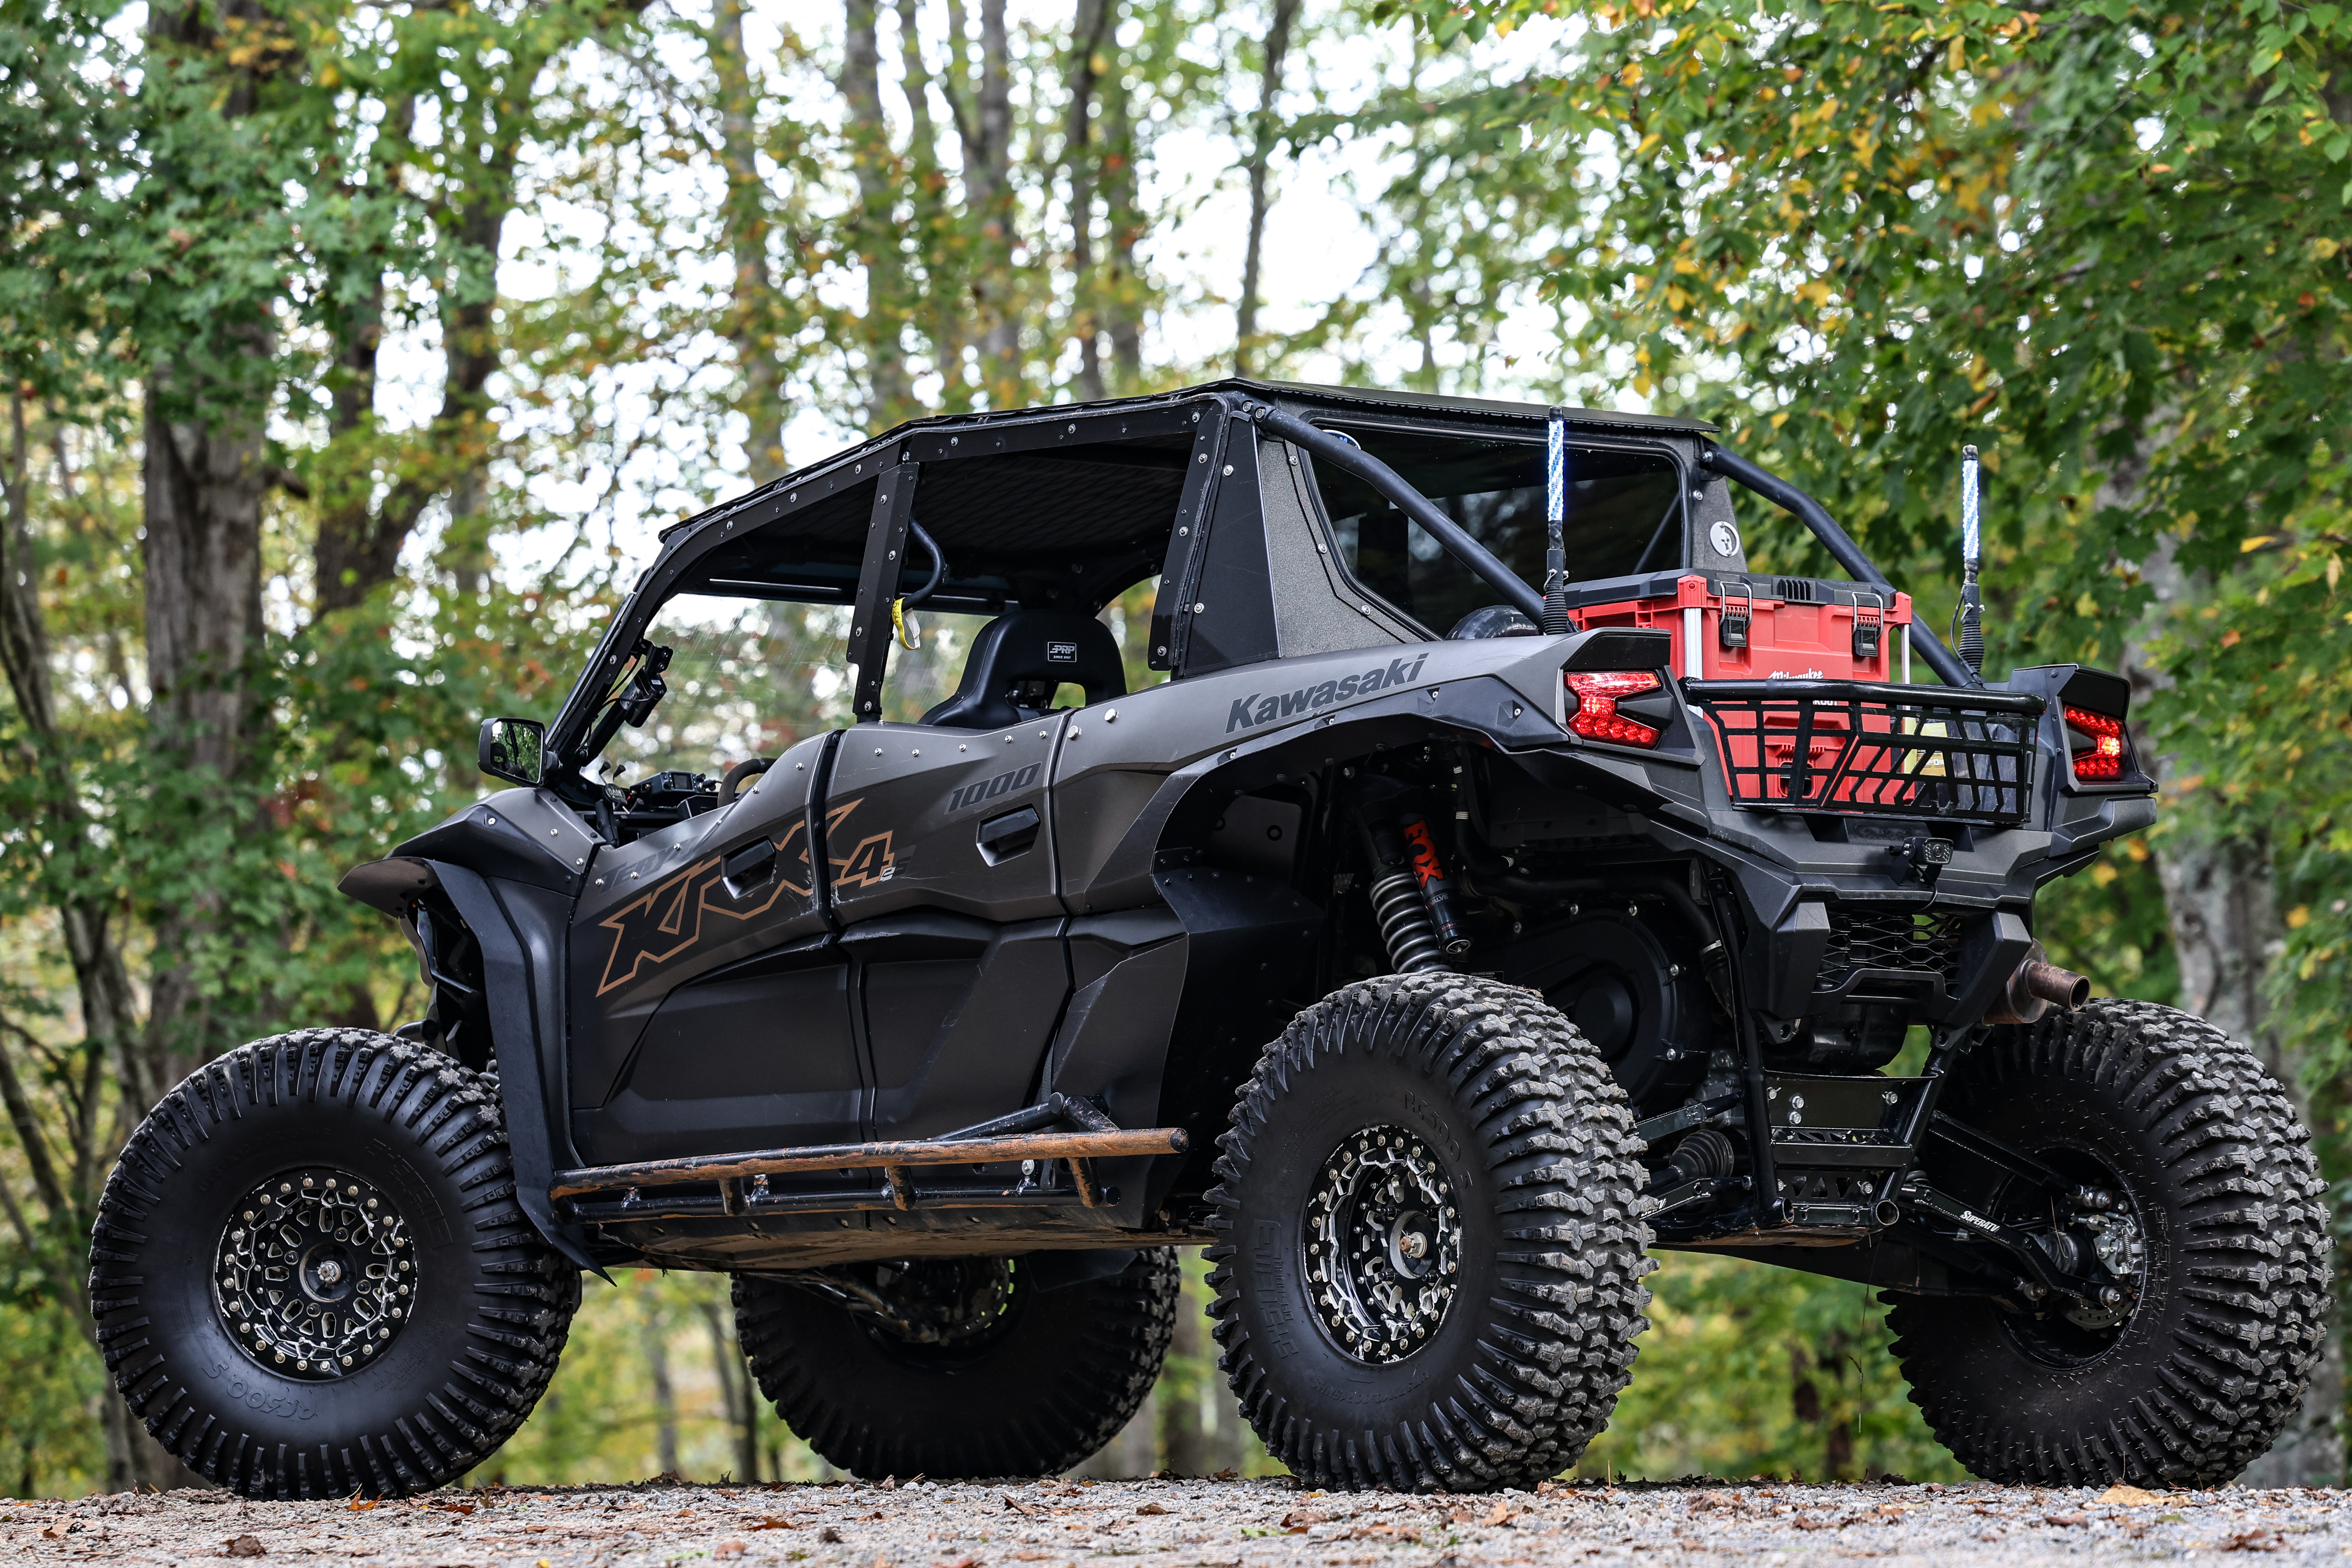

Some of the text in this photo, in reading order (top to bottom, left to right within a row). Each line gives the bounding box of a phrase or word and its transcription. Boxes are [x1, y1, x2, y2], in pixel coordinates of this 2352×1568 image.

[1050, 645, 1075, 654] PRP
[1226, 653, 1429, 734] Kawasaki
[948, 762, 1042, 813] 1000
[1403, 820, 1445, 888] FOX
